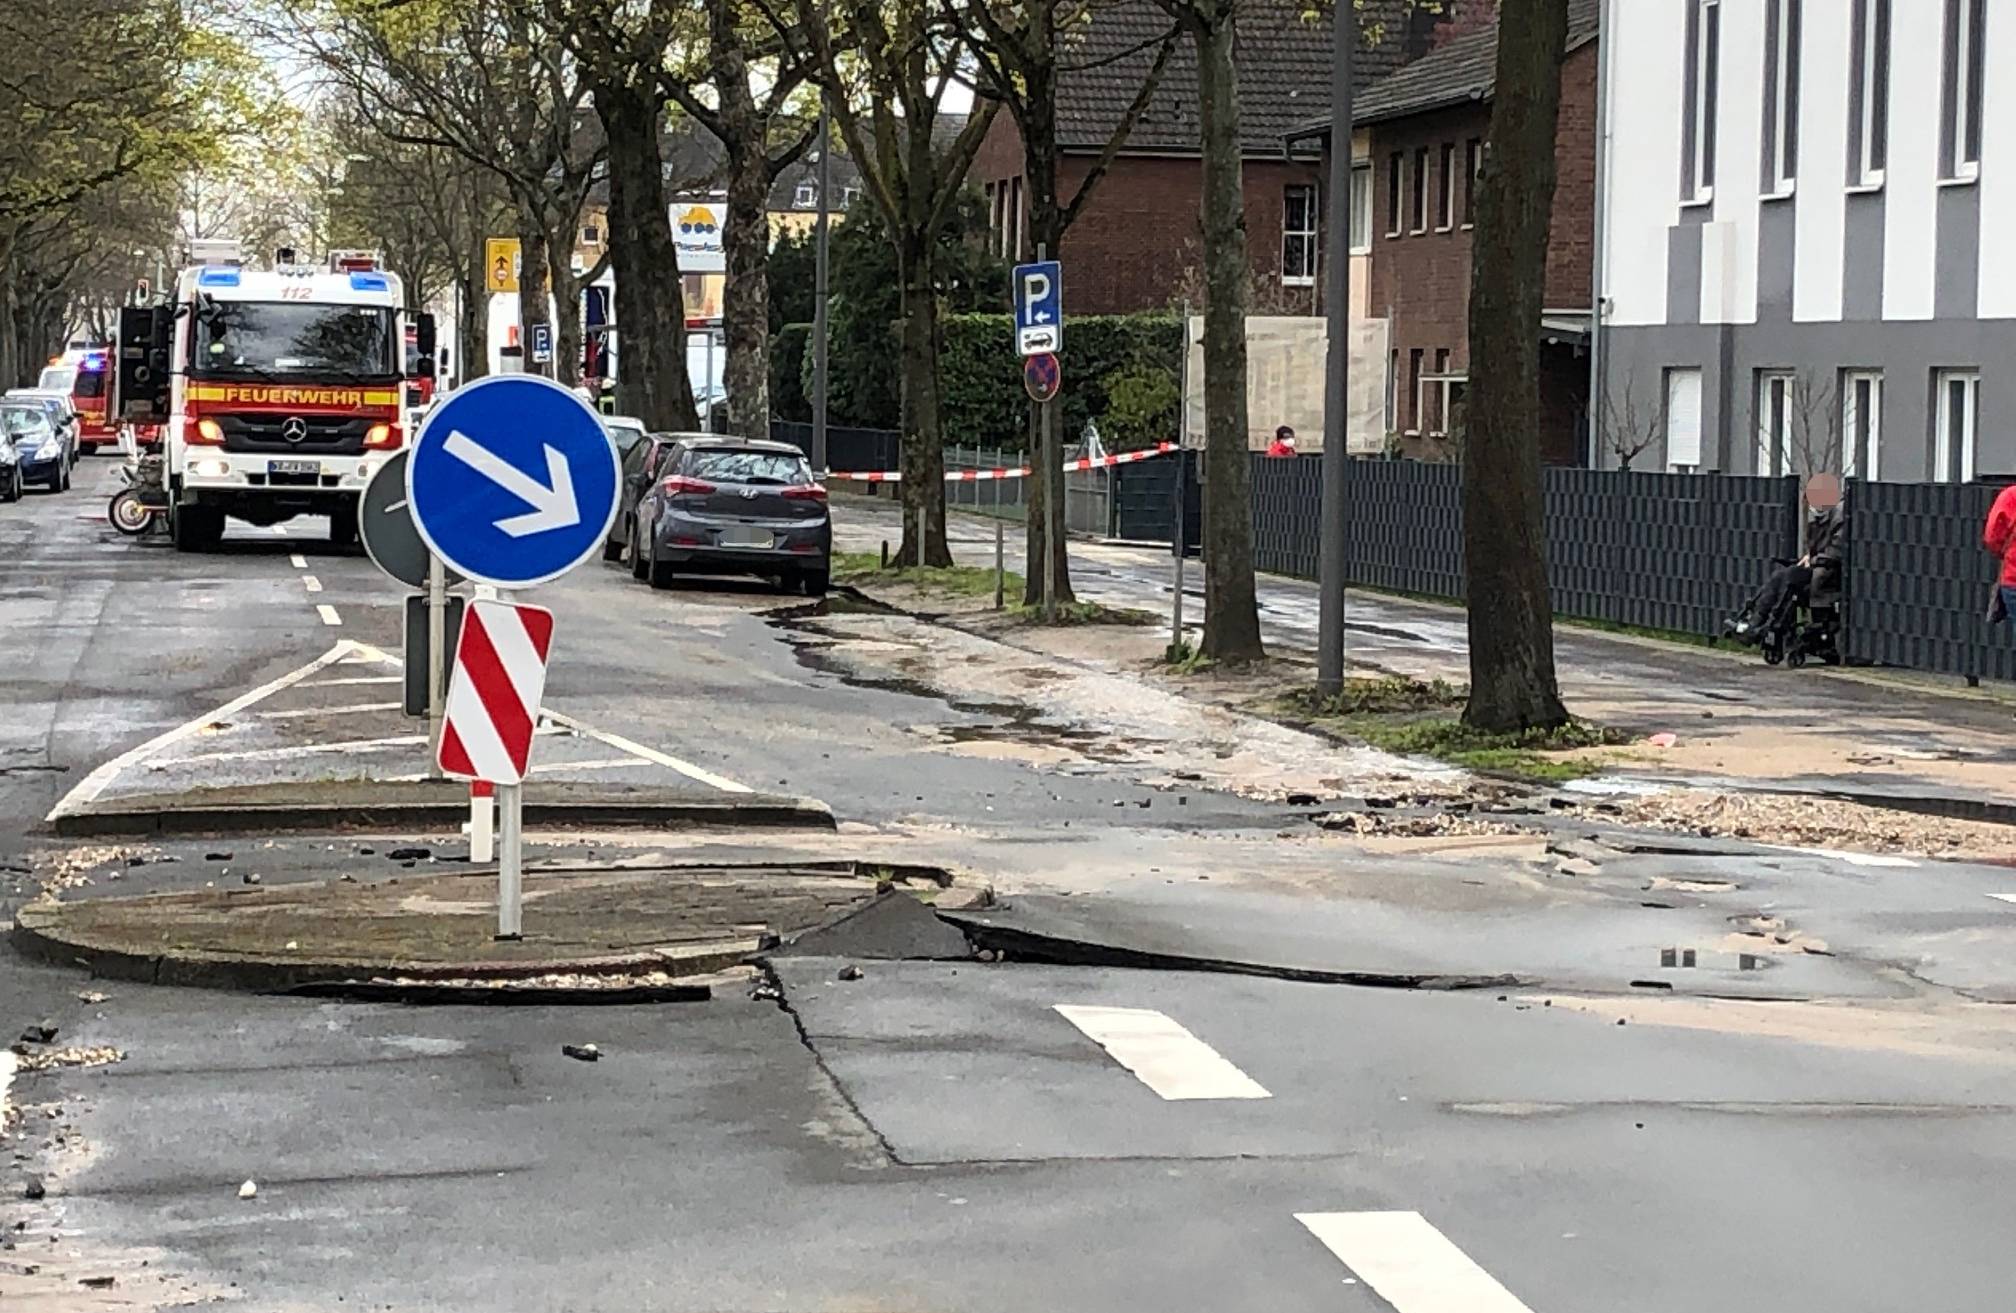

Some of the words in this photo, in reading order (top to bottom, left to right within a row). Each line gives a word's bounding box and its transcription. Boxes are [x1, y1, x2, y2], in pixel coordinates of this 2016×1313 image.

[281, 287, 312, 299] 112
[1025, 273, 1050, 325] P
[536, 329, 547, 350] P
[227, 387, 362, 405] FEUERWEHR
